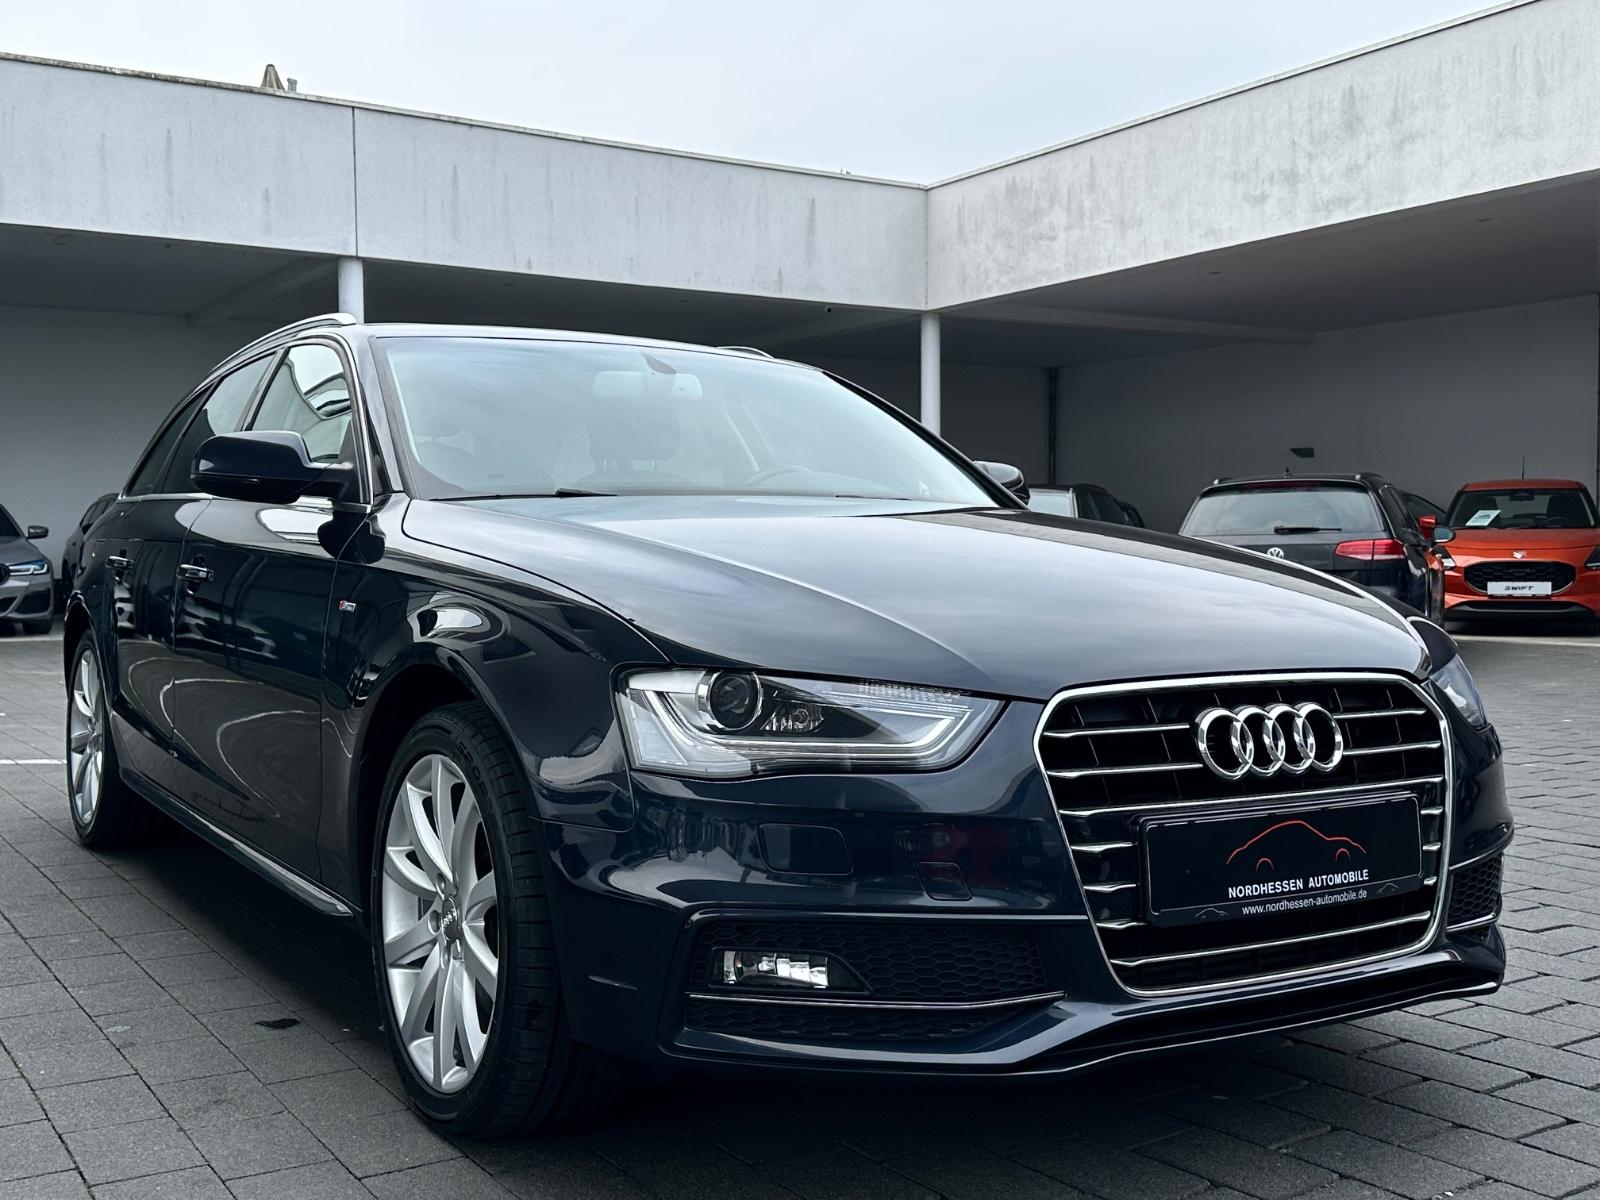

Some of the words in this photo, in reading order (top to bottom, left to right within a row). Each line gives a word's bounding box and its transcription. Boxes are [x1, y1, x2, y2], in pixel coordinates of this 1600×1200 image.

[1228, 879, 1304, 899] NORDHESSEN
[1308, 869, 1369, 889] AUTOMOBILE
[1242, 888, 1367, 915] www.nordhessen-automobile.de
